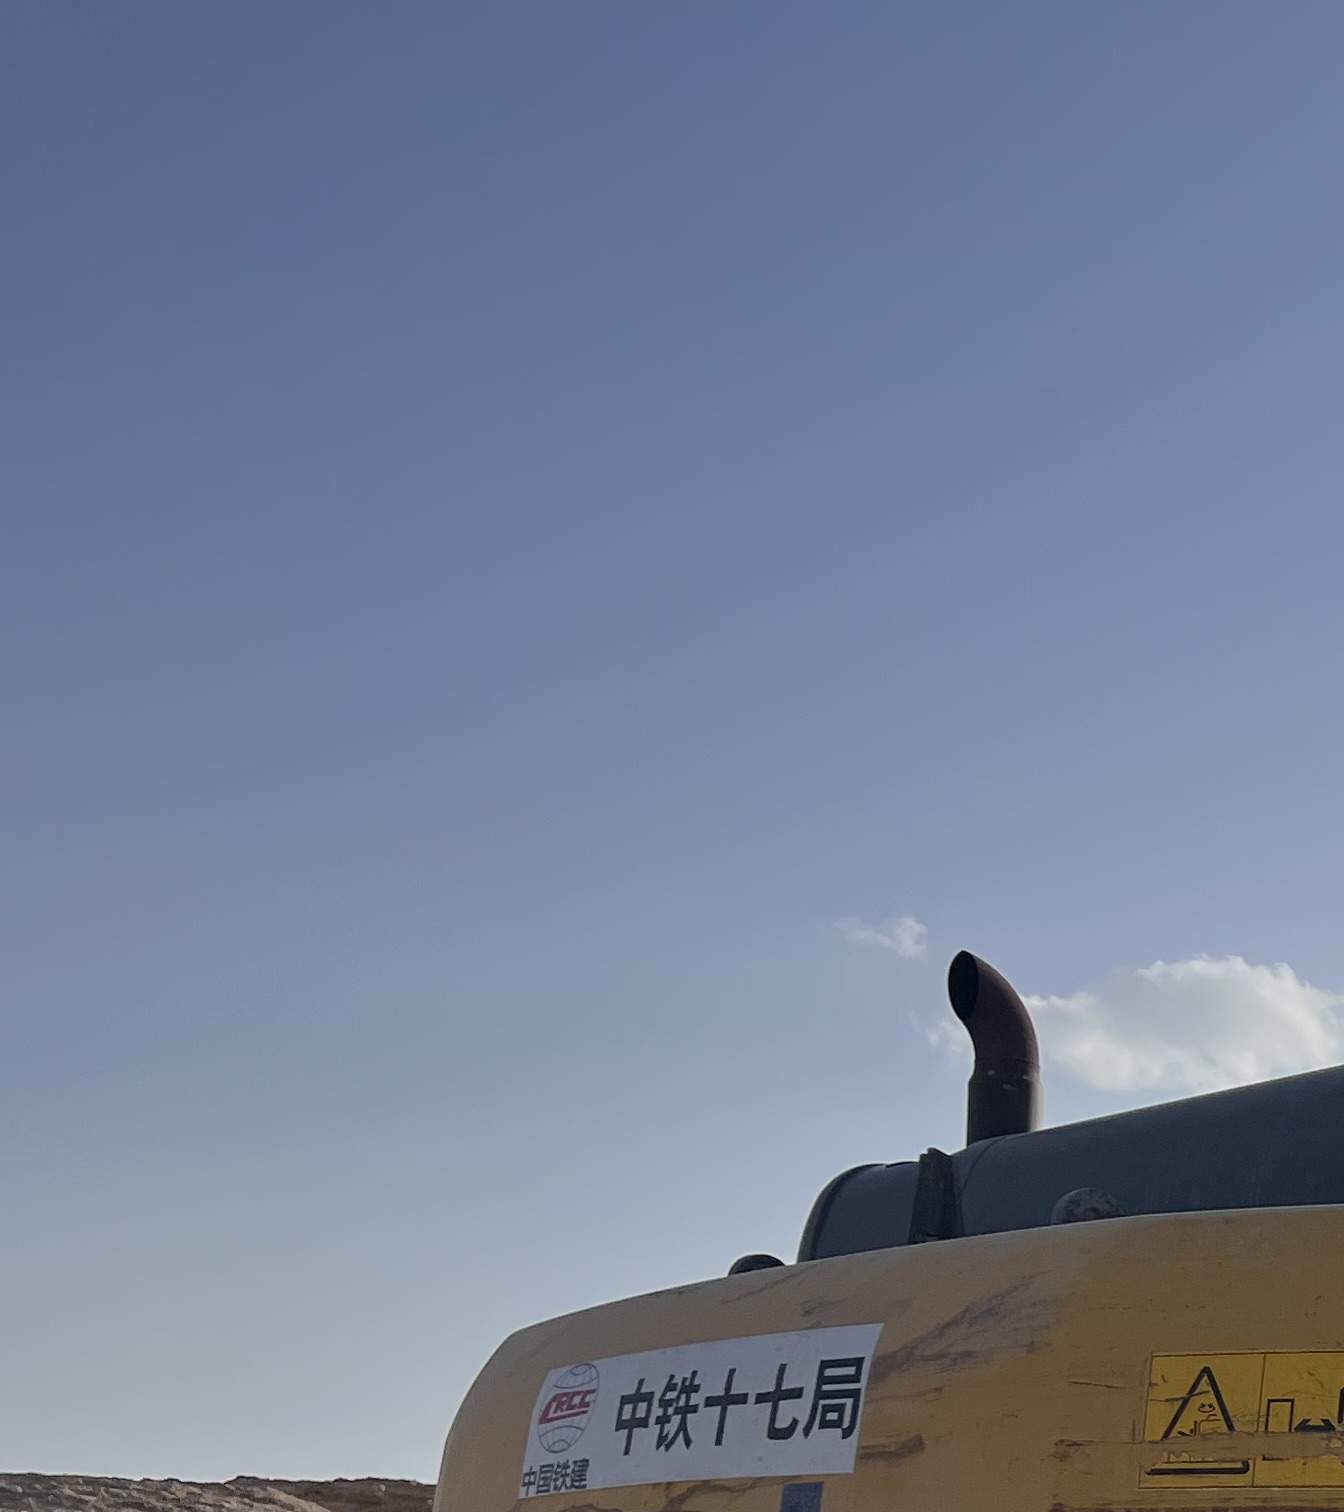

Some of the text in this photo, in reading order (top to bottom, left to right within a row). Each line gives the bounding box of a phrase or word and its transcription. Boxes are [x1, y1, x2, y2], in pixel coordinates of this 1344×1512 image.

[538, 1388, 597, 1425] CRCC
[612, 1356, 866, 1457] 中铁十七局
[520, 1457, 590, 1497] 中国铁建
